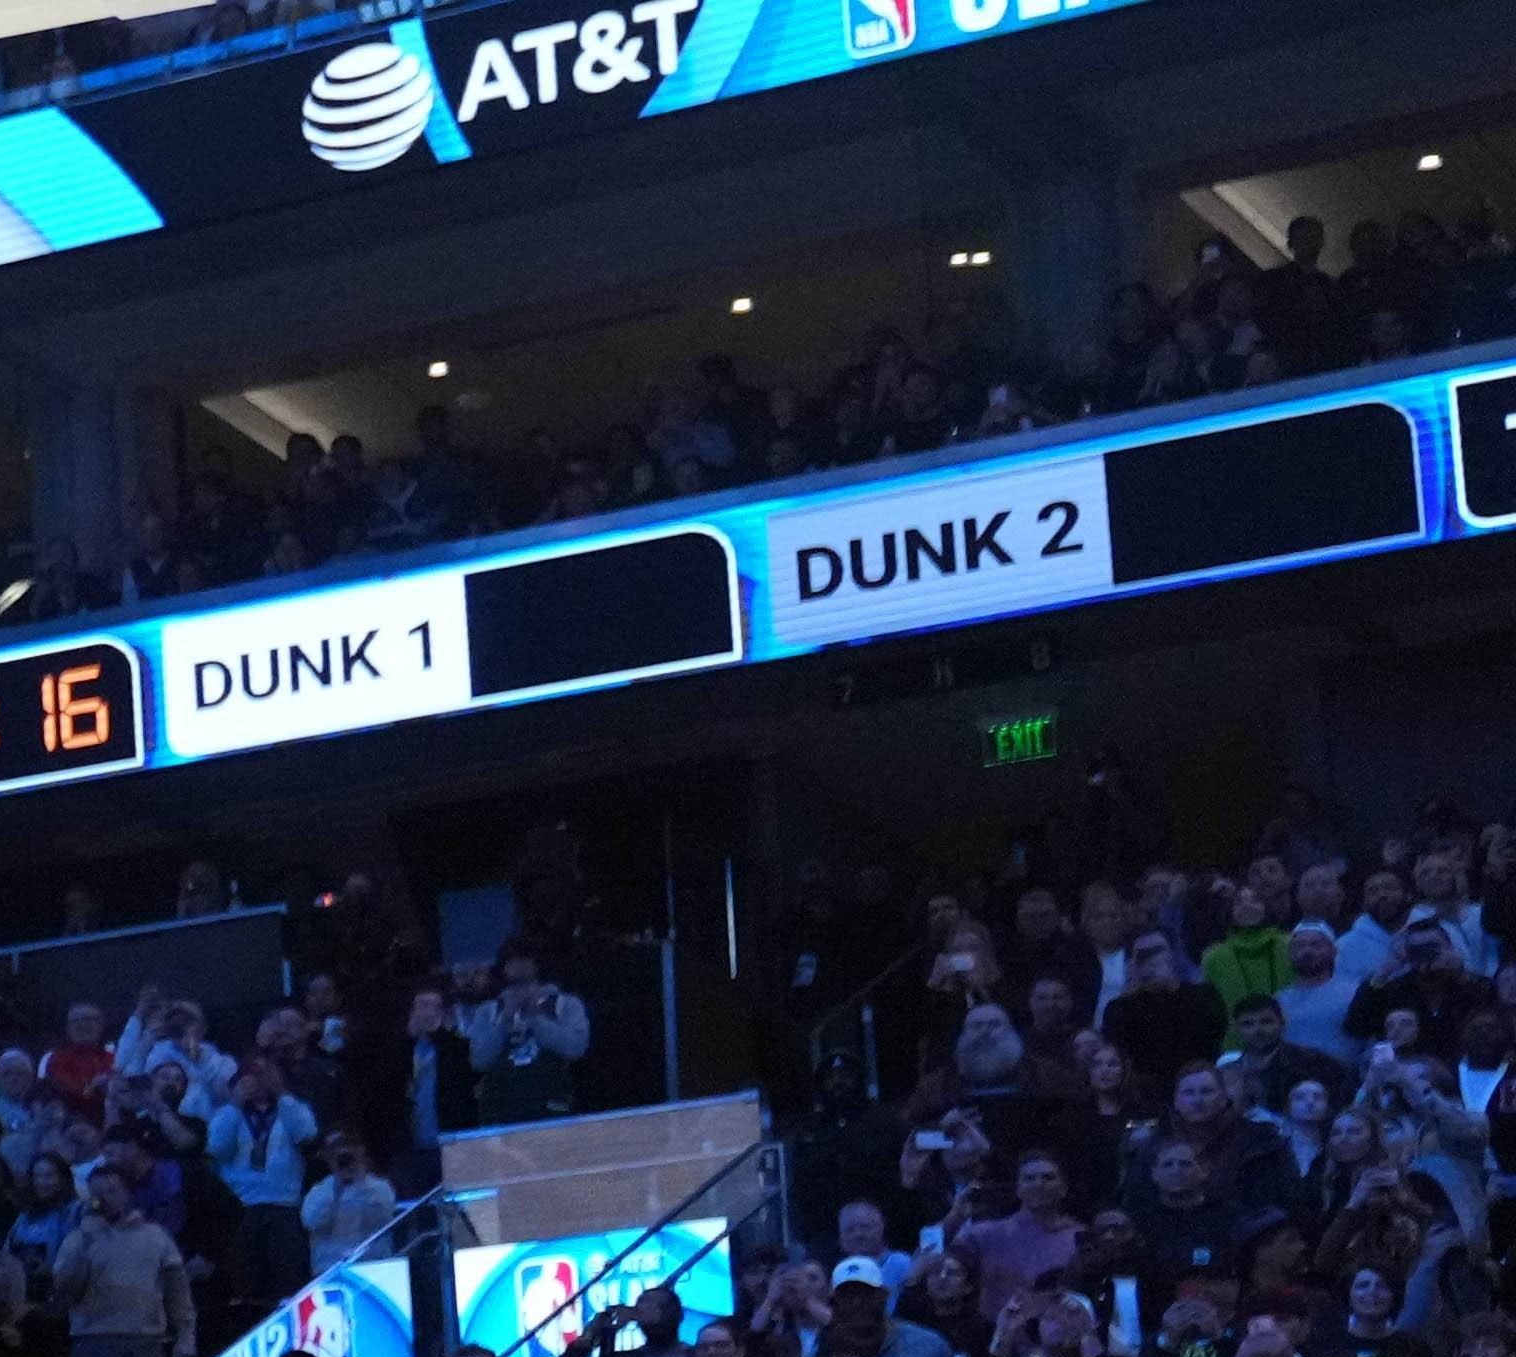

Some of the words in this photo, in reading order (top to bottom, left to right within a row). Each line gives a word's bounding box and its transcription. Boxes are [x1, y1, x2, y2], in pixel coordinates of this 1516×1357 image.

[458, 0, 698, 120] AT&T
[797, 508, 1012, 602] DUNK
[1036, 498, 1084, 556] 2
[193, 630, 382, 711] DUNK
[404, 618, 437, 673] 1
